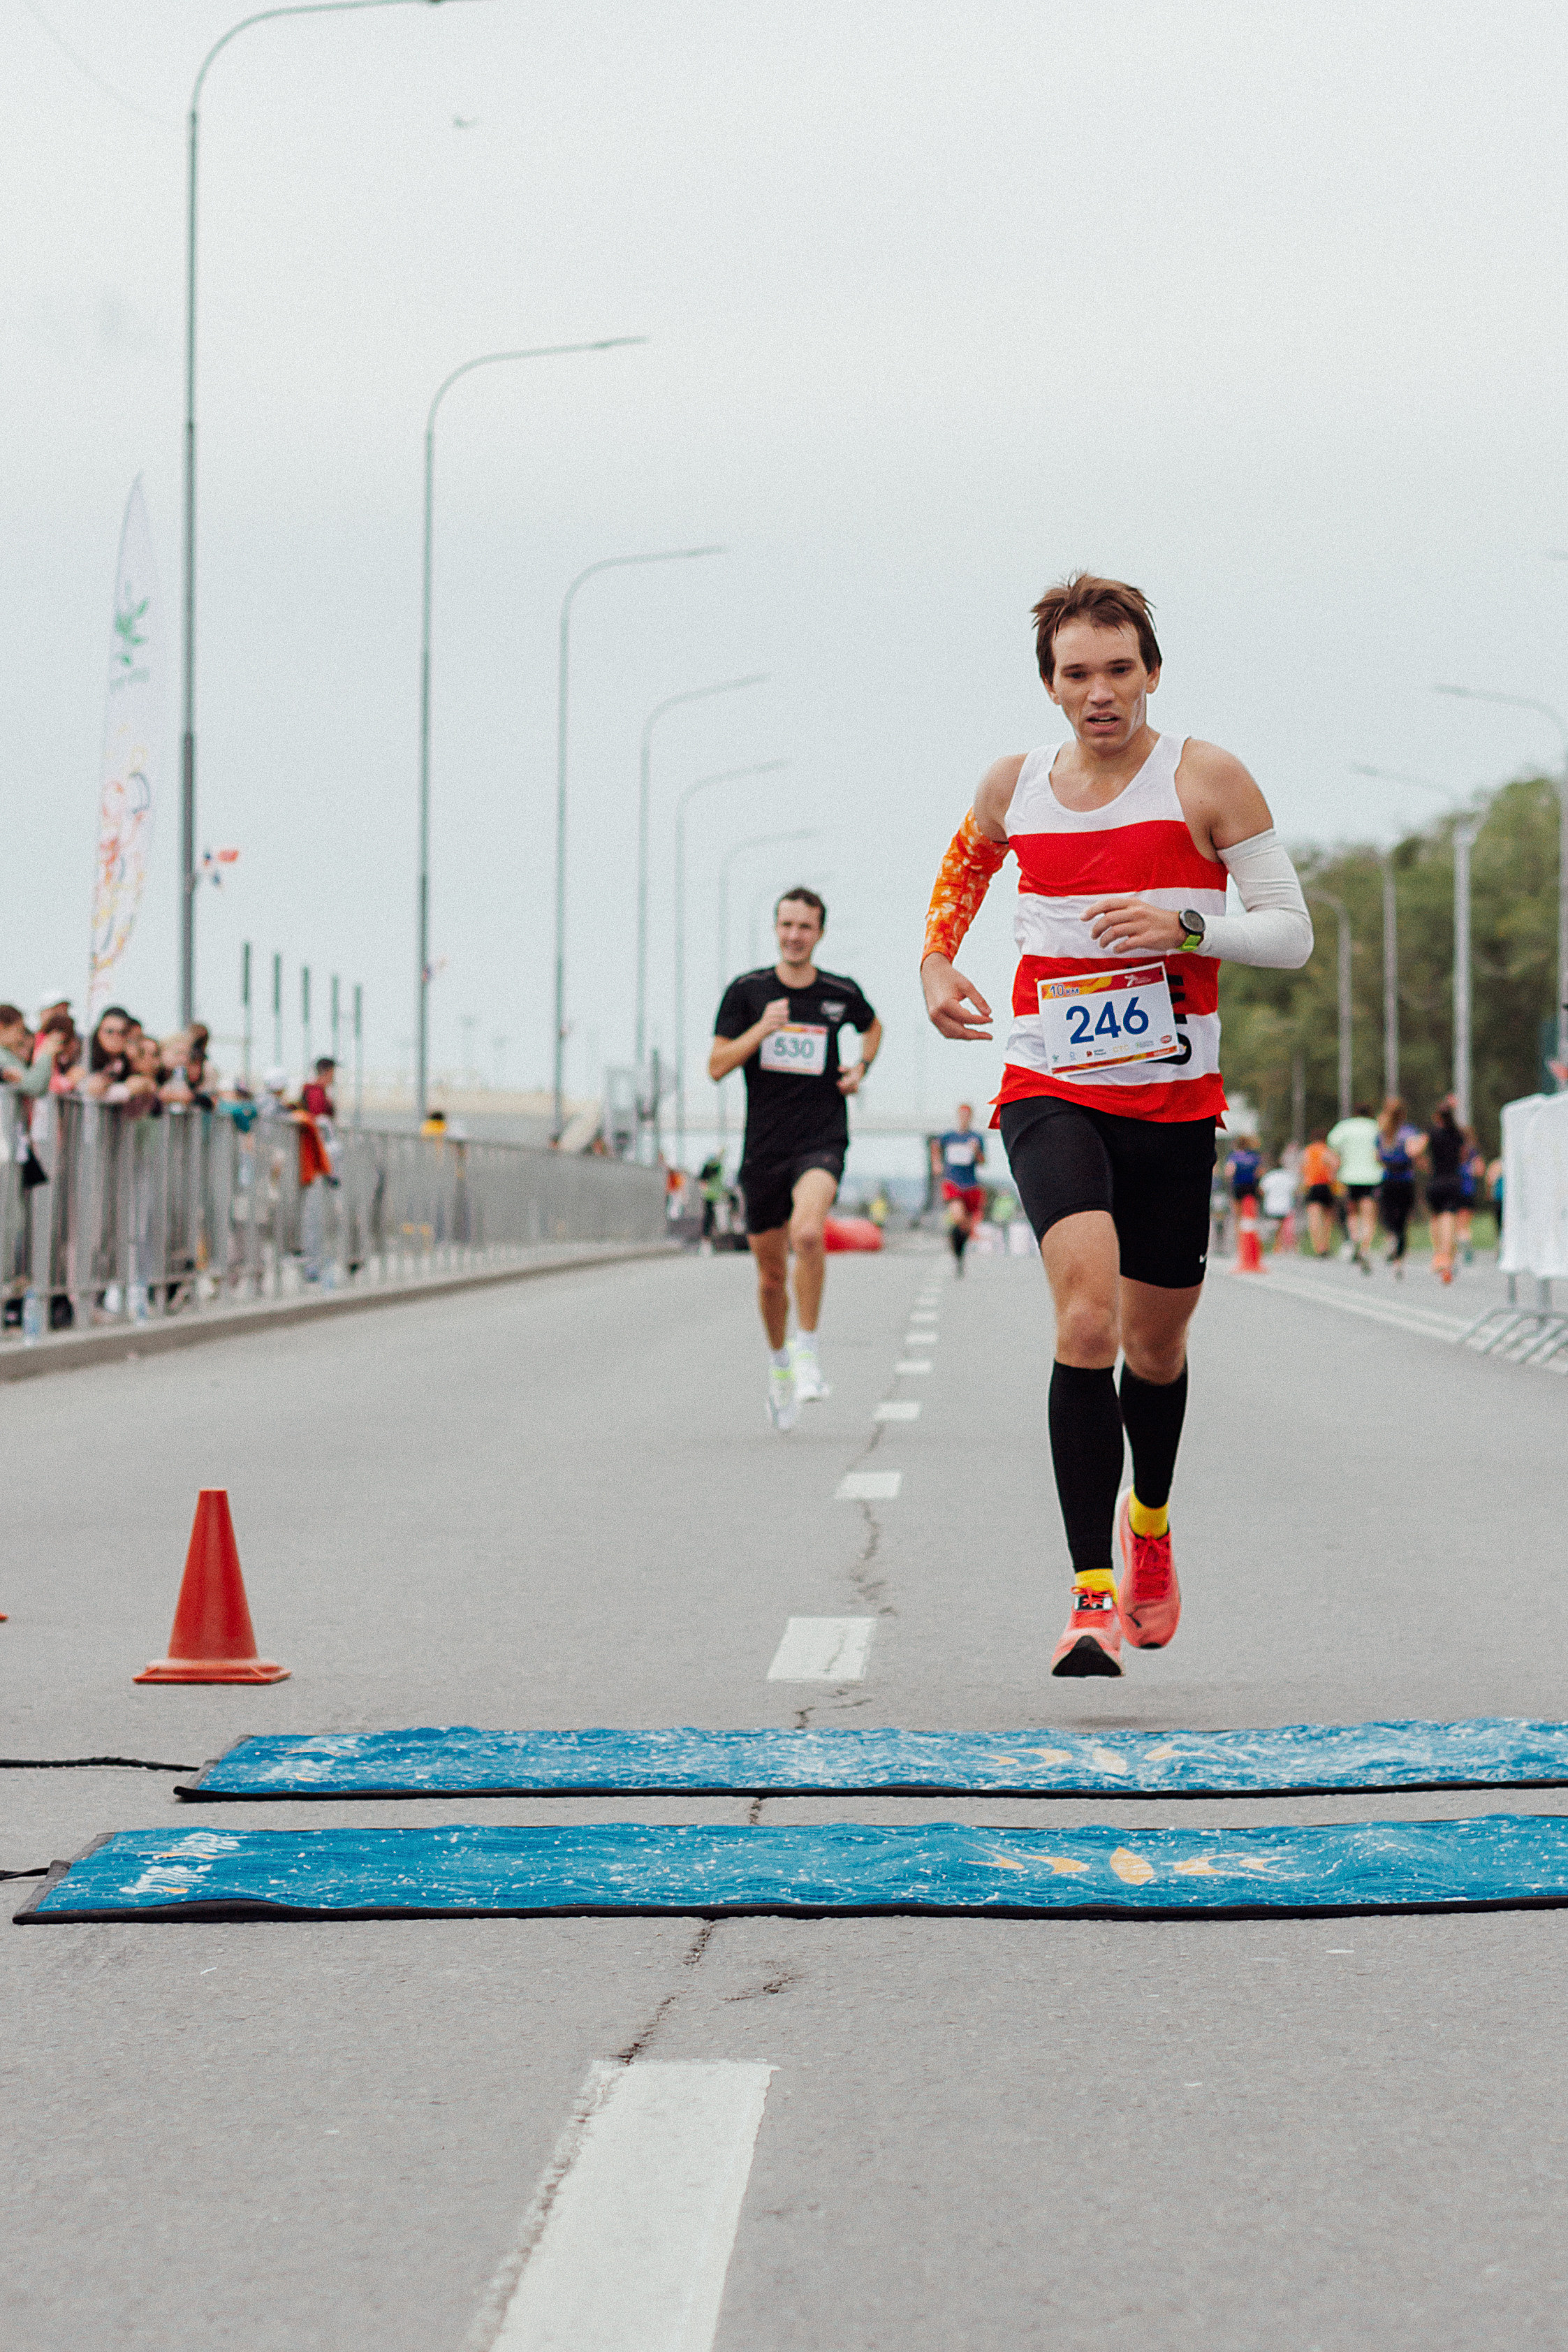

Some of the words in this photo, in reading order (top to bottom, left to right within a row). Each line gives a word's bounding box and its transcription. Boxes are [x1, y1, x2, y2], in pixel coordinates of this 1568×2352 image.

[1049, 983, 1064, 998] 10
[1066, 996, 1149, 1044] 246
[773, 1036, 814, 1058] 530
